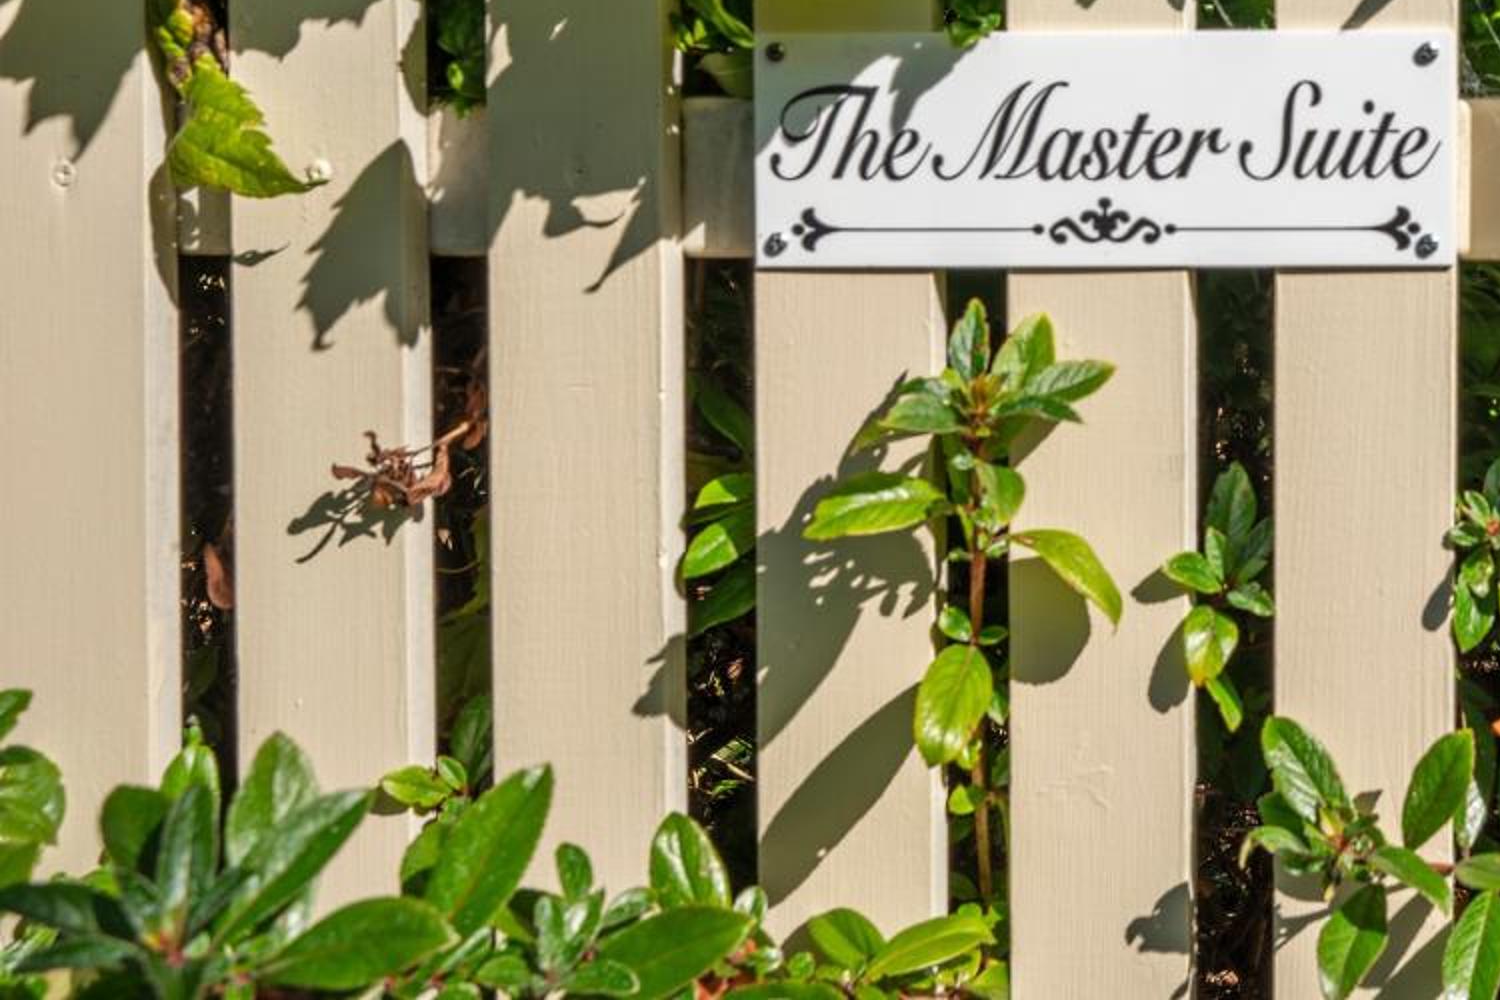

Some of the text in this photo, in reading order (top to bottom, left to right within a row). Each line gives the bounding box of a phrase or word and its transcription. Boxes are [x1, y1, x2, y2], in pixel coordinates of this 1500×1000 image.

[769, 79, 1441, 181] The Master Suite
